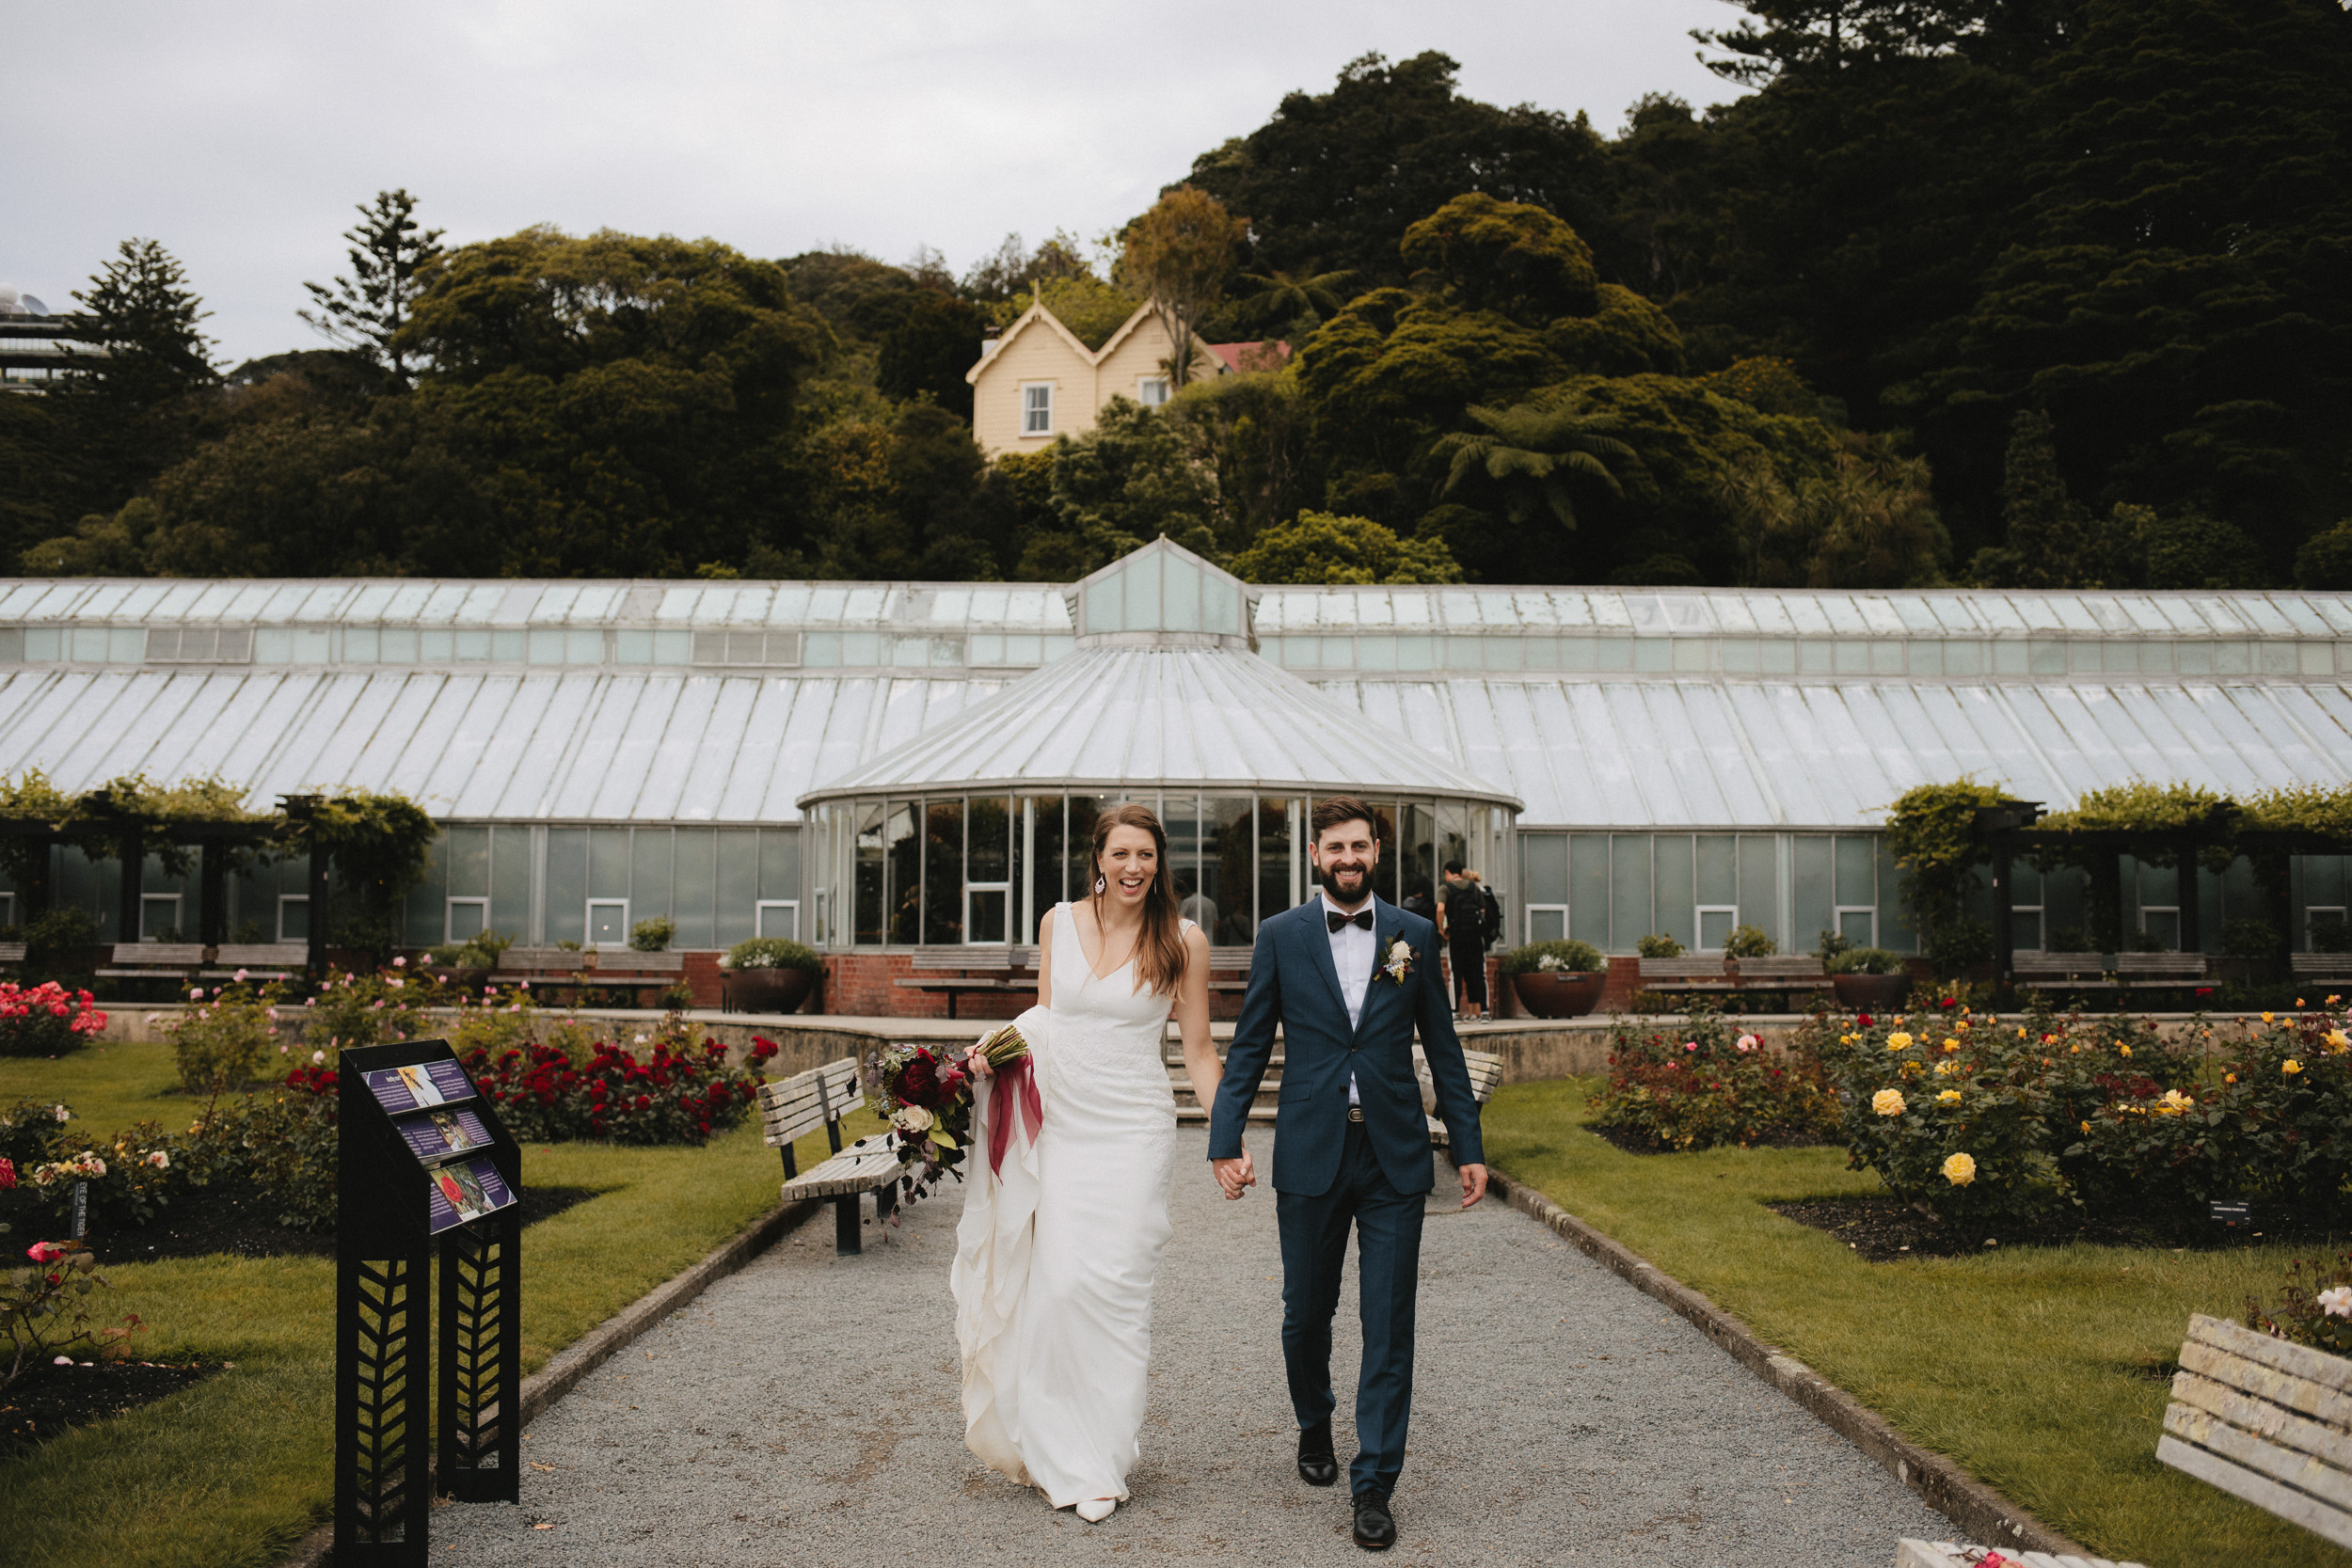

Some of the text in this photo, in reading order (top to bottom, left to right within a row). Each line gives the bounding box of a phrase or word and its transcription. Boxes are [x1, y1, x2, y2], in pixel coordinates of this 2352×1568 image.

[77, 1181, 87, 1236] EYE OF THE TIGER
